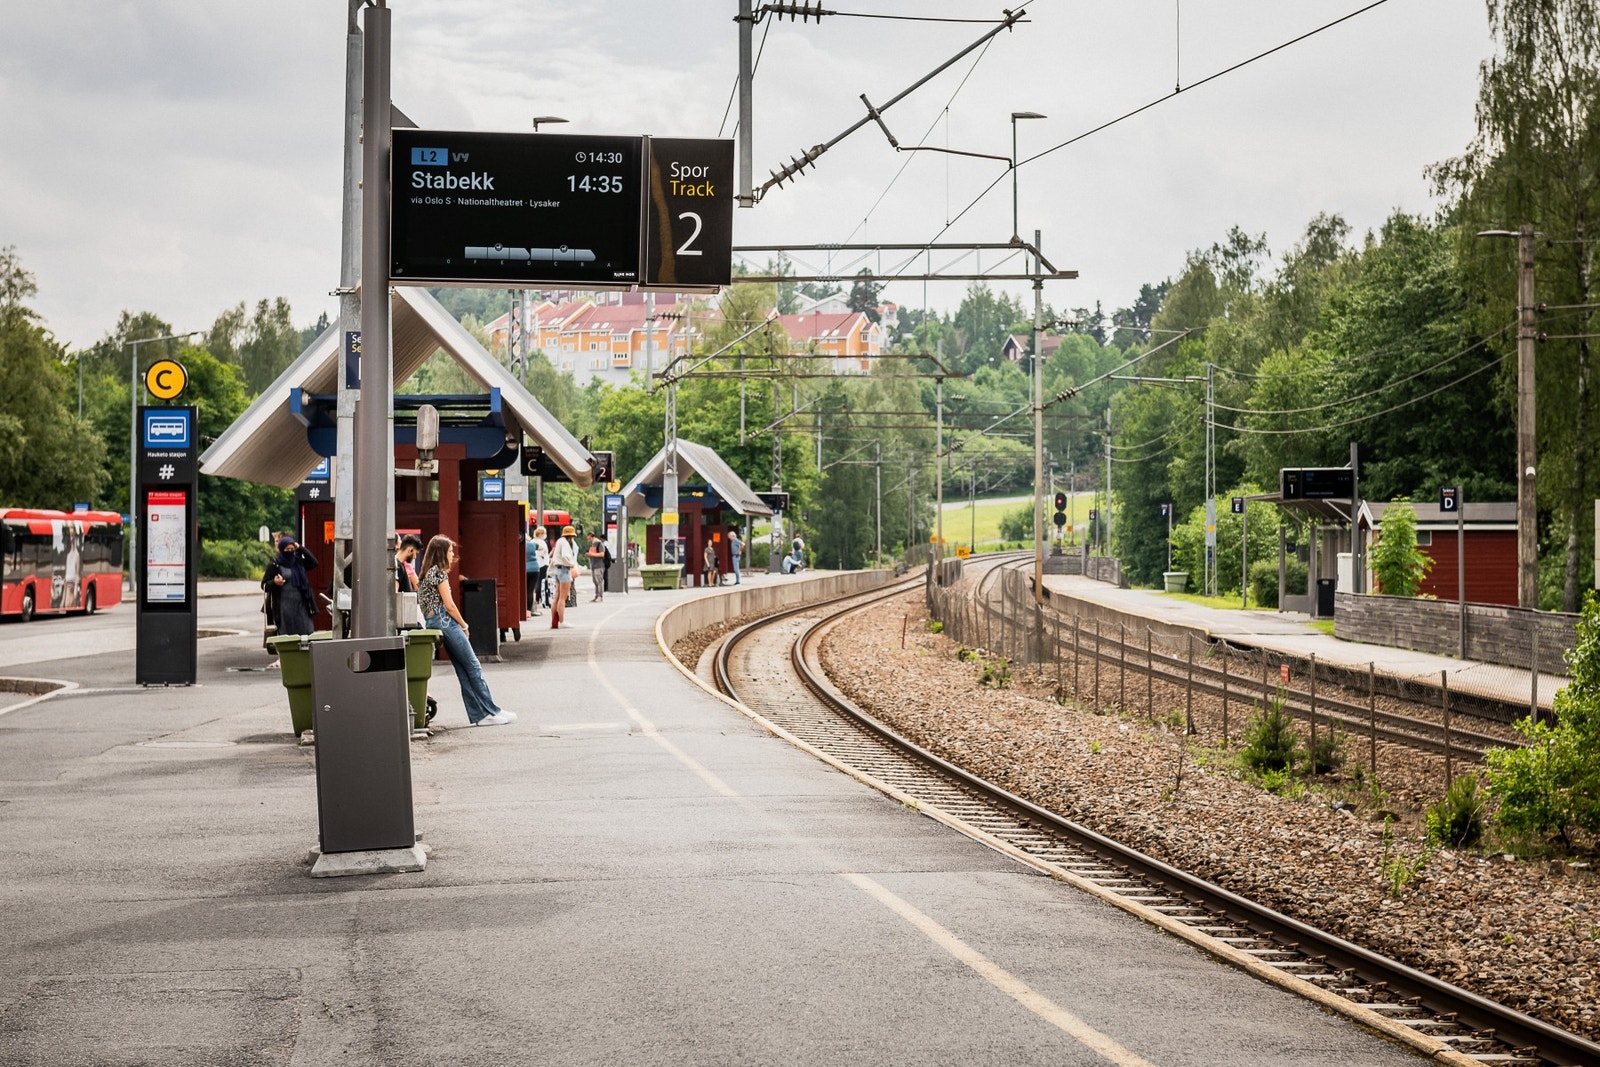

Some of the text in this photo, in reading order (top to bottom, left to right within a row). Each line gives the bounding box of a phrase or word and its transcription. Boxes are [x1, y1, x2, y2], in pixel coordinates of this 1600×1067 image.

[421, 150, 437, 162] L2
[589, 152, 623, 163] 14:30
[670, 161, 709, 181] Spor
[411, 170, 623, 193] Stabekk 14:35
[669, 180, 714, 197] Track
[410, 196, 560, 208] via Oslo S Nationaltheatret Lysaker
[676, 211, 702, 256] 2
[155, 369, 173, 390] C
[169, 451, 187, 459] stasjon
[527, 458, 537, 472] C
[600, 466, 606, 478] 2
[1235, 503, 1240, 512] E
[1444, 497, 1454, 509] D
